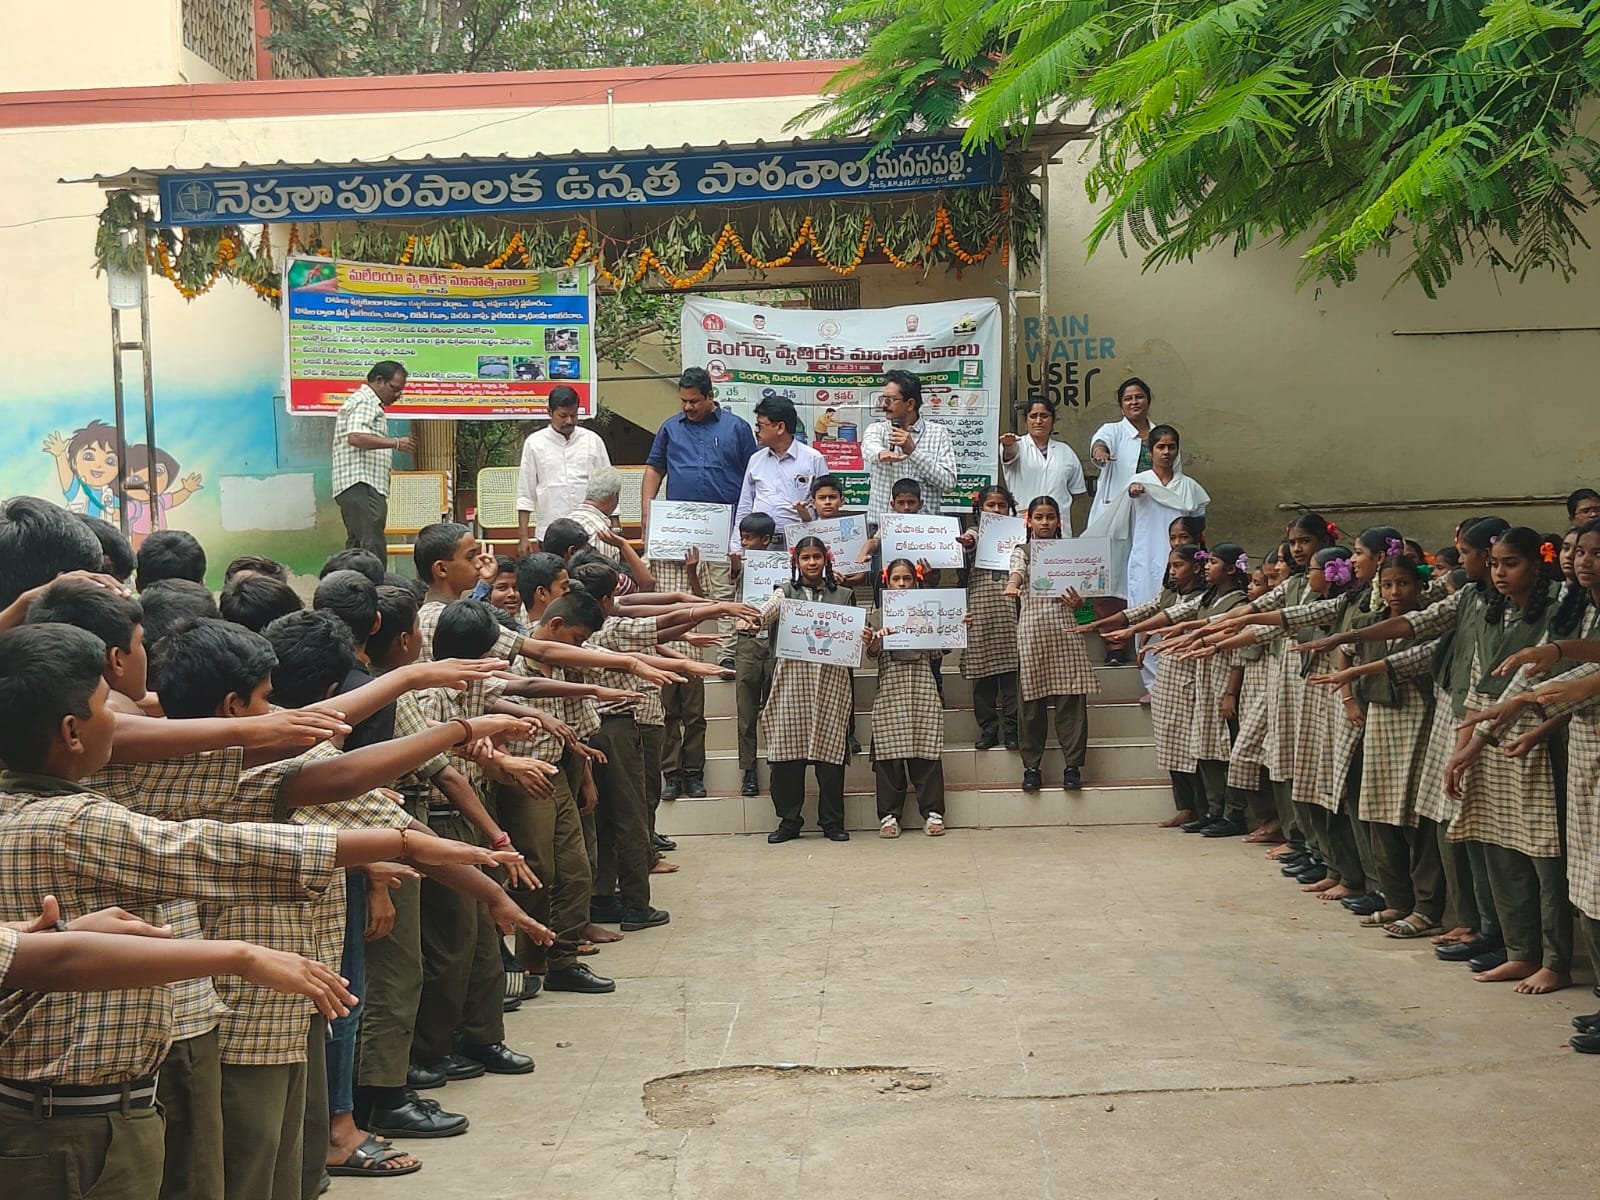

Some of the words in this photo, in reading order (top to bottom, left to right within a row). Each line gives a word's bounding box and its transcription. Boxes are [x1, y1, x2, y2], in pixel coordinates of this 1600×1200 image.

[556, 161, 681, 202] ఉన్నత
[1024, 313, 1089, 340] RAIN
[707, 339, 771, 364] డెంగ్యూ
[775, 343, 846, 366] వ్యతిరేక
[850, 343, 980, 364] మాసోత్సవాలు
[1025, 337, 1116, 363] WATER
[818, 376, 826, 384] 3
[1026, 362, 1079, 386] USE
[794, 605, 814, 618] మన
[886, 607, 905, 617] మన
[791, 624, 810, 635] మన
